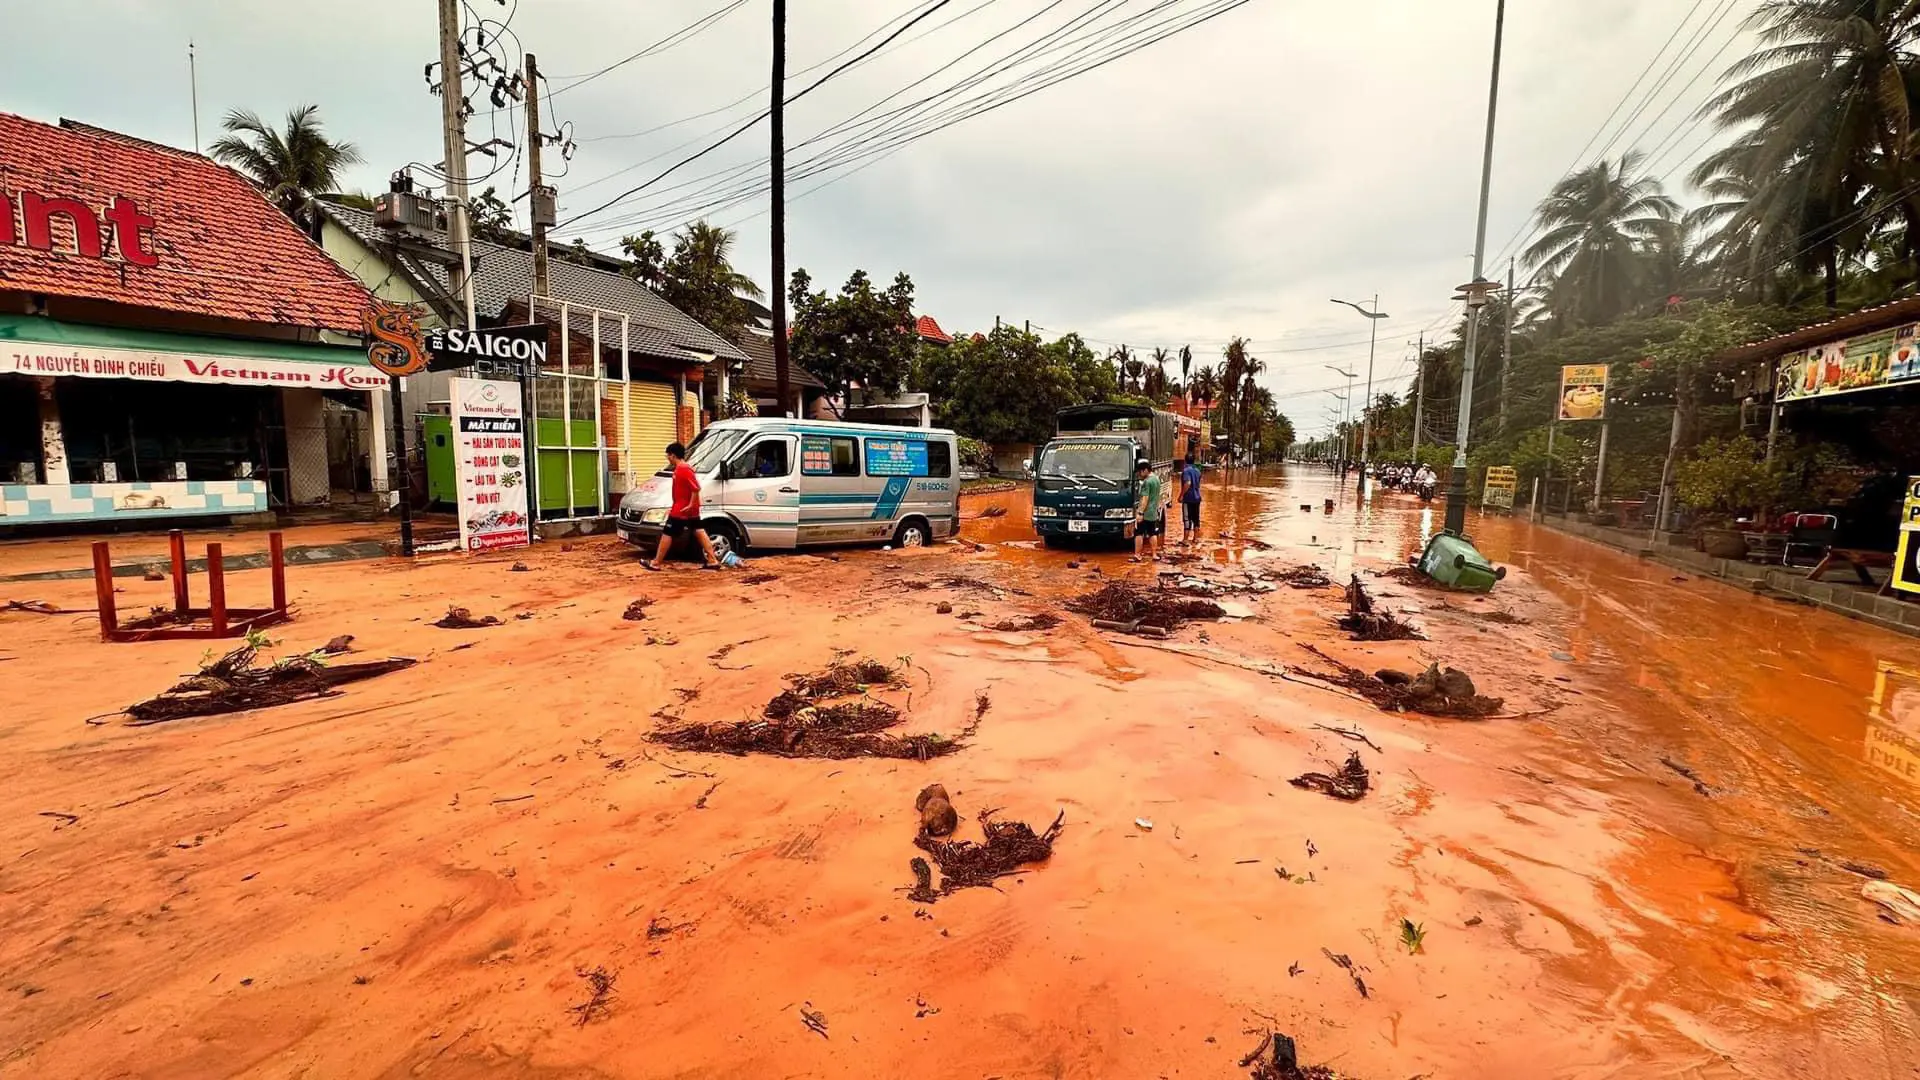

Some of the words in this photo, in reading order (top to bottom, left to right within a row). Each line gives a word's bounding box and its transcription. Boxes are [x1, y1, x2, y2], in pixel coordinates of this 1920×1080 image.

[432, 327, 446, 350] BIA
[447, 328, 548, 362] SAIGON
[12, 354, 31, 370] 74
[94, 355, 125, 375] ĐÌNH
[183, 359, 311, 382] Vietnam
[319, 367, 391, 390] Hom
[463, 402, 494, 413] Vietnam
